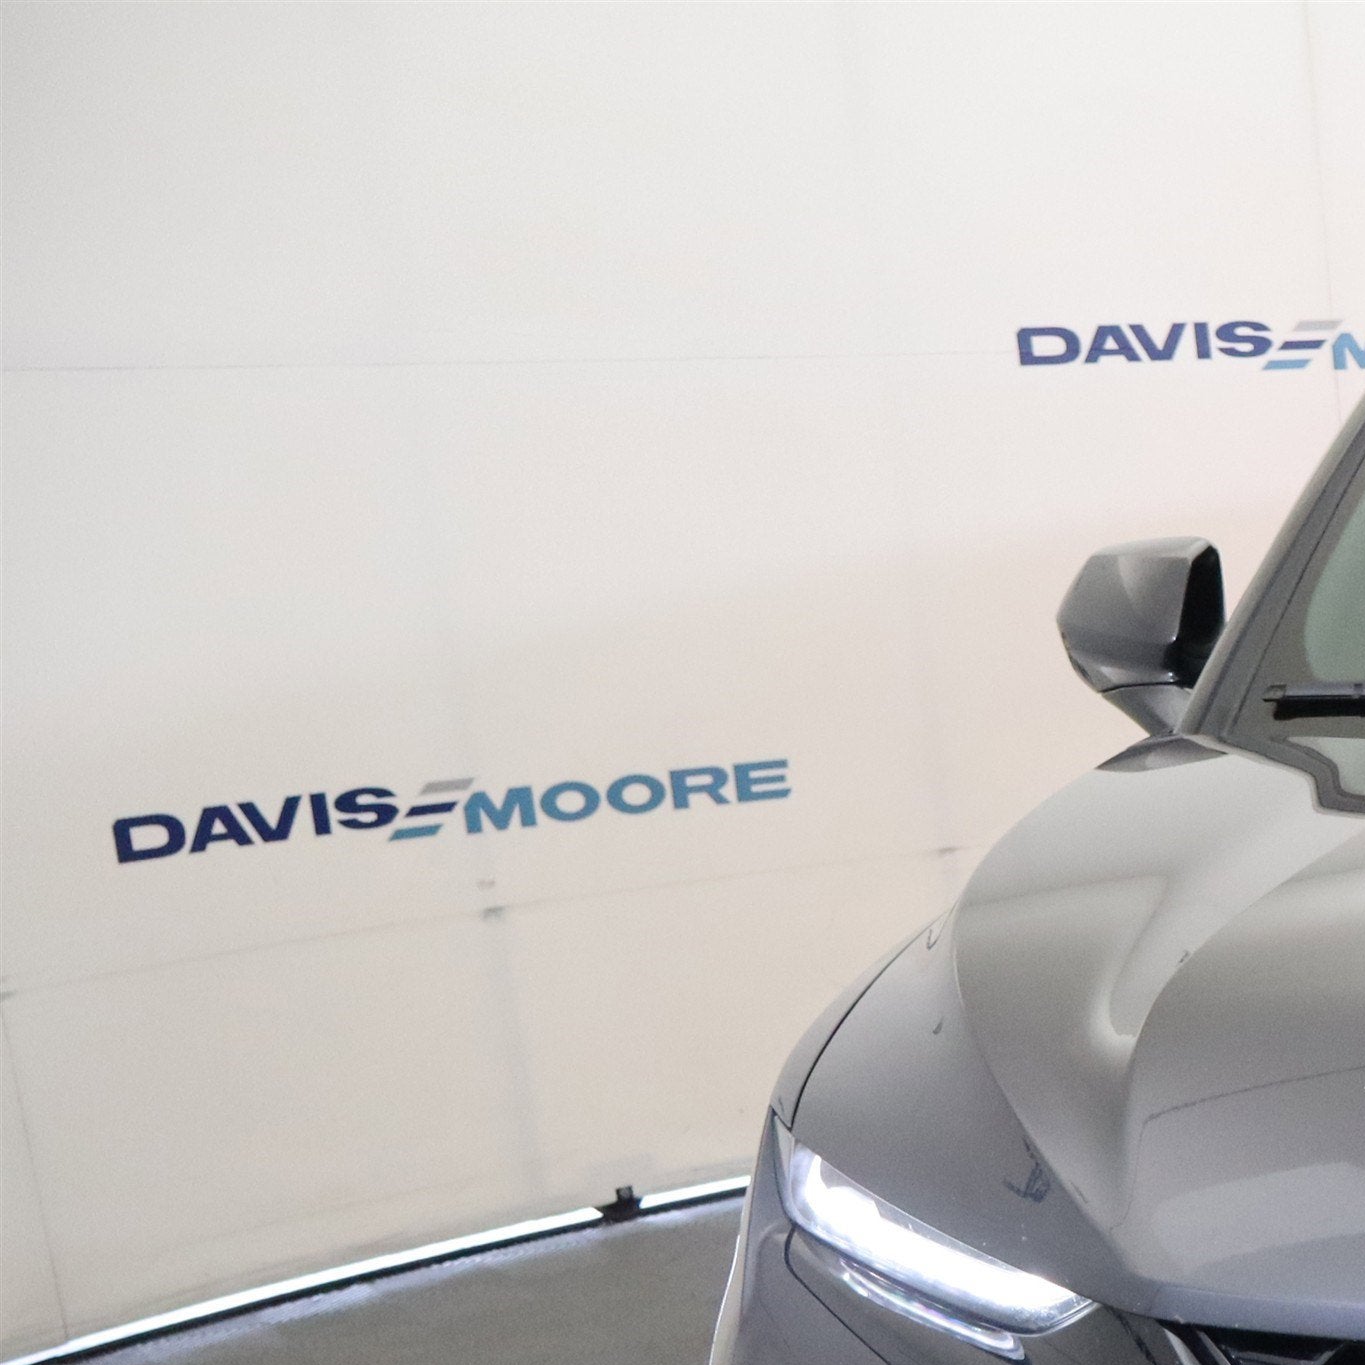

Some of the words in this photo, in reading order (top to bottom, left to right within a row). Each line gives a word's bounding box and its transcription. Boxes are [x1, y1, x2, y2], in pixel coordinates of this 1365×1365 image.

[1016, 319, 1273, 367] DAVIS
[111, 786, 400, 864] DAVIS
[462, 758, 793, 835] MOORE
